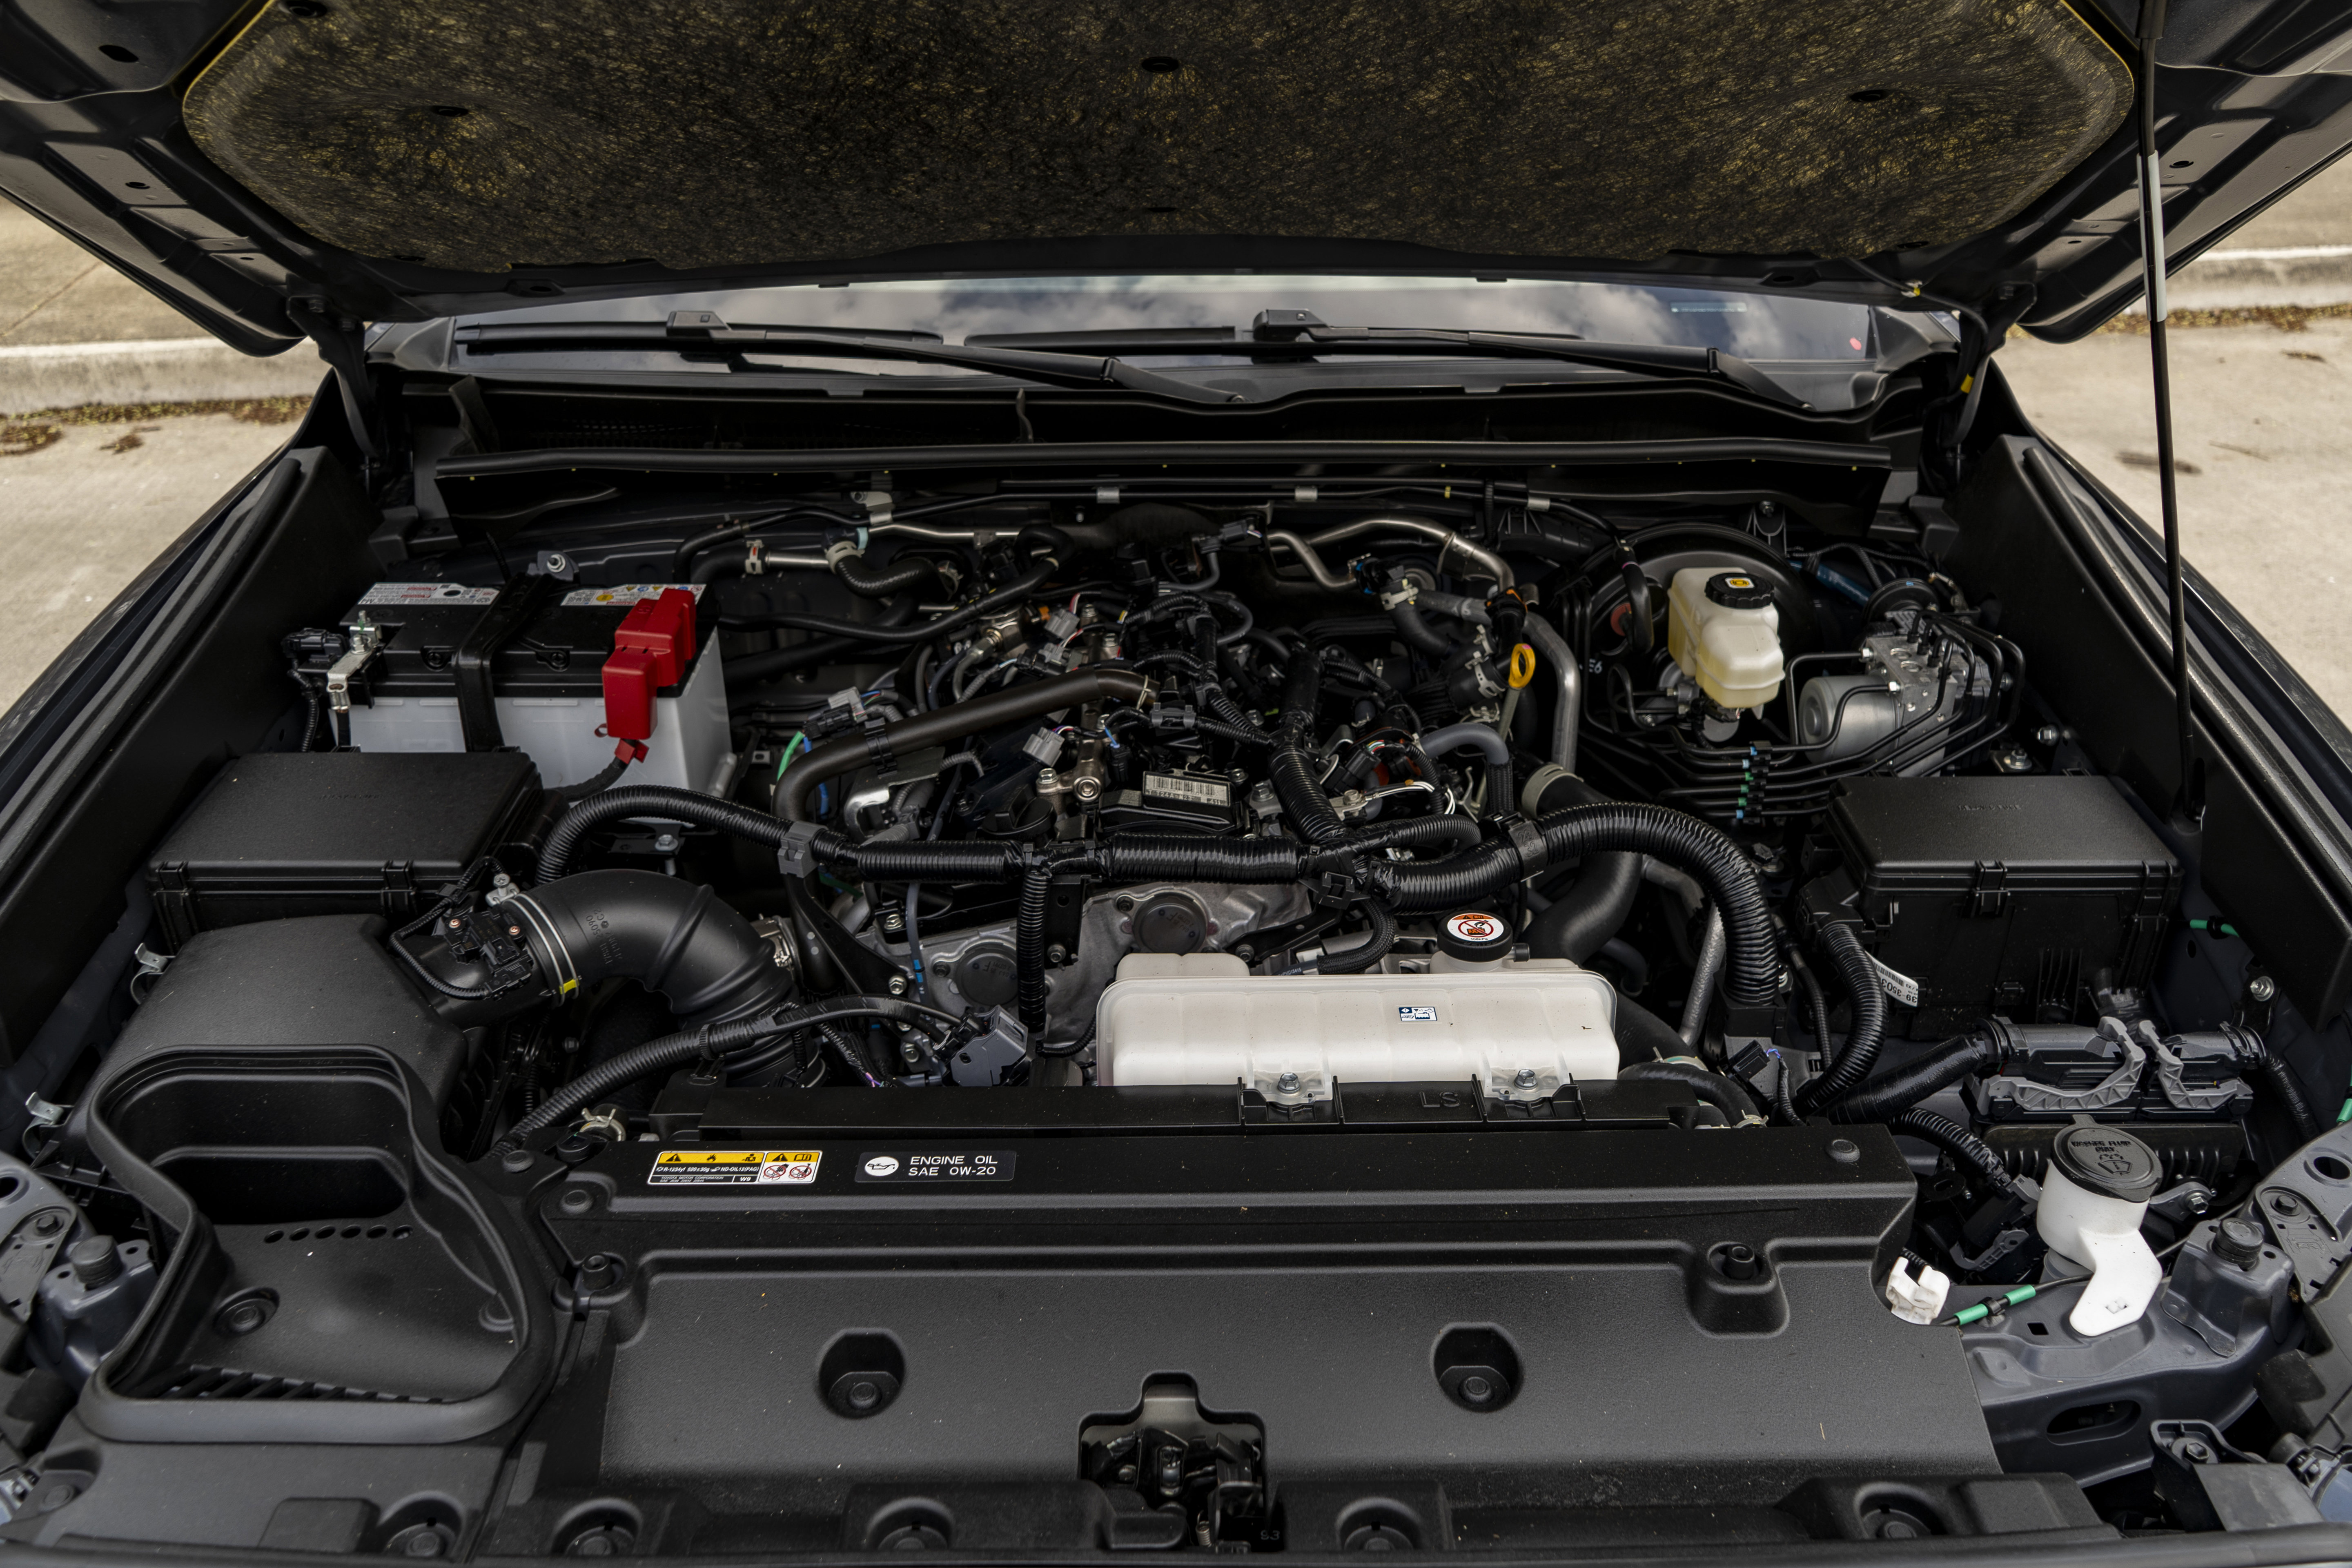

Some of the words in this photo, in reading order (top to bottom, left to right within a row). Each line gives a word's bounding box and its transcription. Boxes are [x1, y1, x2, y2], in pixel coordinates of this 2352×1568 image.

[1419, 1091, 1461, 1108] LS
[910, 1156, 965, 1165] ENGINE
[975, 1155, 998, 1164] OIL
[908, 1167, 939, 1176] SAE
[949, 1167, 996, 1176] 0W-20
